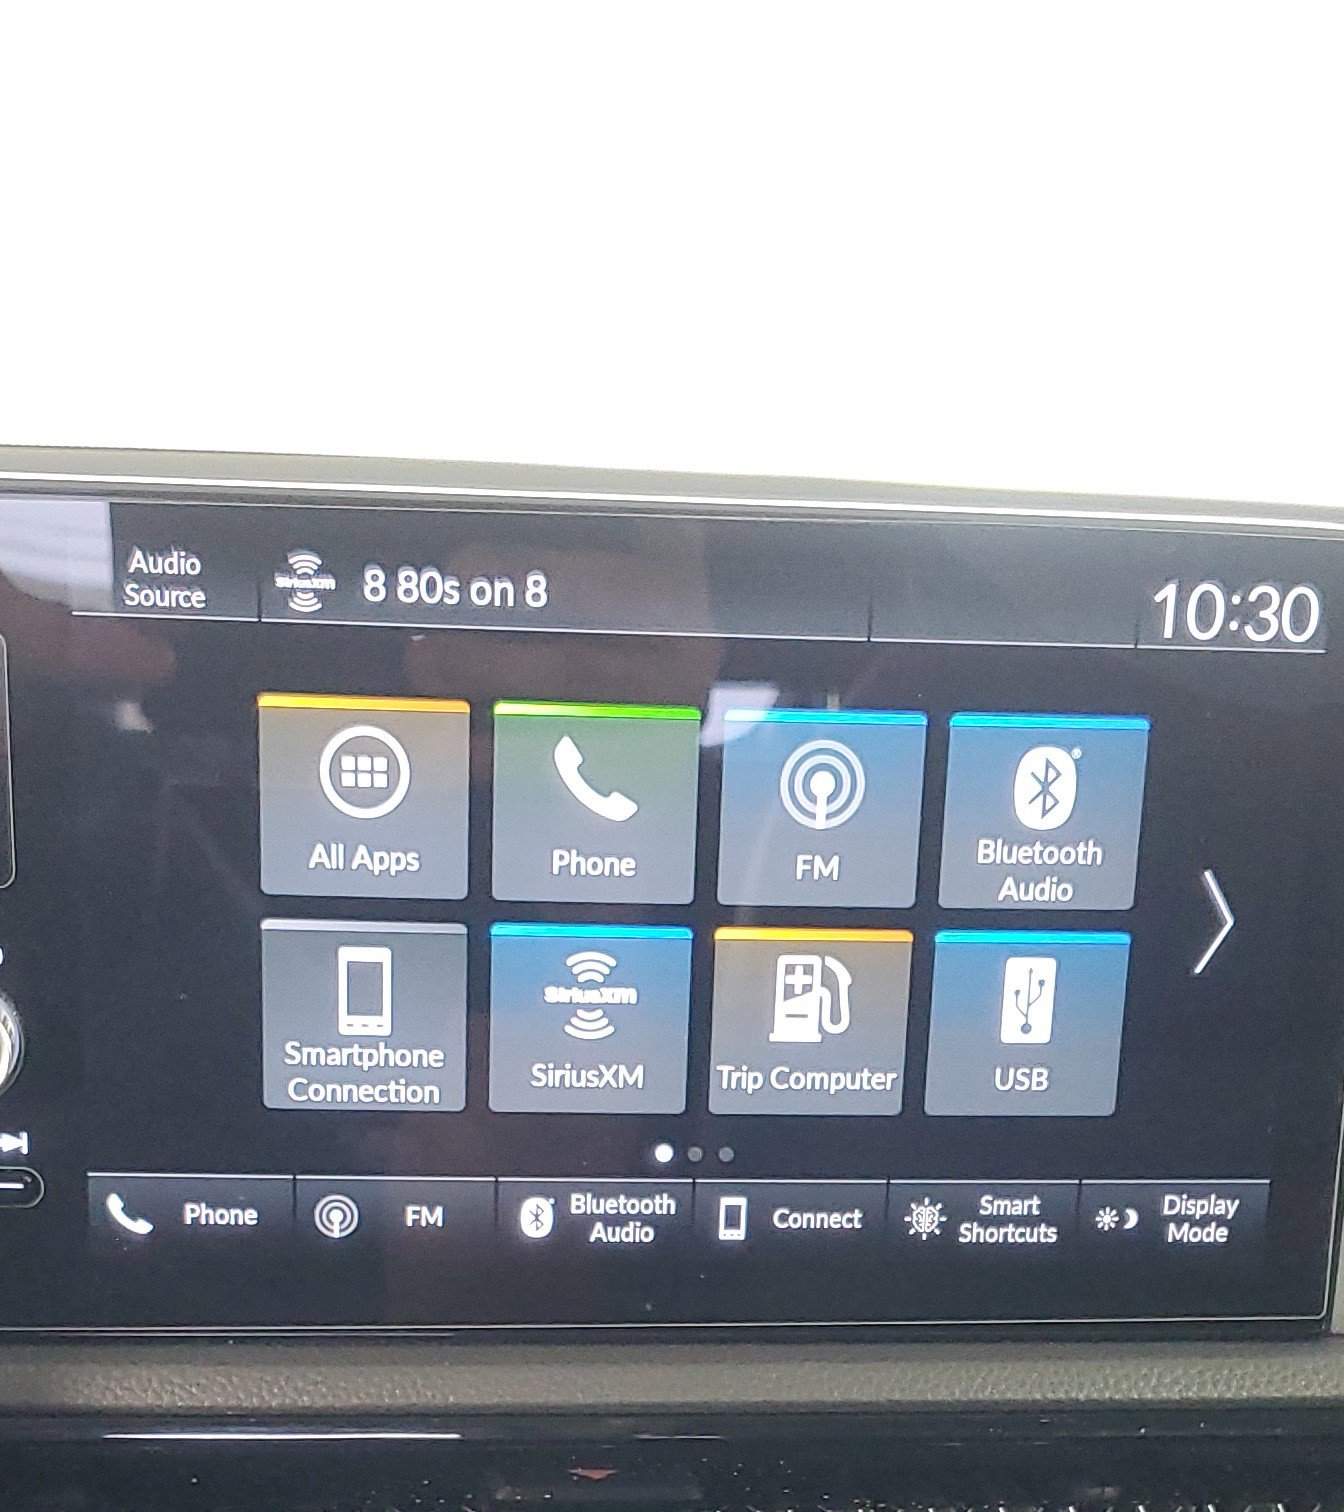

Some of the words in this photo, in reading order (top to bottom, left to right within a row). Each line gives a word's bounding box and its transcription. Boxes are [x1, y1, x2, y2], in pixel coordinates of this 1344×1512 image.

[127, 548, 202, 580] Audio
[124, 580, 206, 612] Source
[363, 565, 387, 602] 8
[396, 567, 461, 606] 80s
[469, 578, 516, 608] on
[524, 570, 549, 609] 8
[1153, 578, 1321, 645] 10:30
[308, 842, 345, 873] All
[350, 844, 421, 878] Apps
[551, 849, 637, 878] Phone
[795, 853, 840, 882] FM
[976, 838, 1103, 868] Bluetooth
[998, 874, 1074, 904] Audio
[284, 1041, 445, 1075] Smartphone
[286, 1076, 441, 1106] Connection
[529, 1063, 644, 1091] SiriusXM
[716, 1064, 764, 1096] Trip
[770, 1065, 899, 1096] Computer
[993, 1066, 1050, 1093] USB
[183, 1200, 260, 1228] Phone
[404, 1204, 445, 1229] FM
[568, 1191, 677, 1218] Bluetooth
[772, 1206, 863, 1231] Connect
[978, 1195, 1042, 1219] Smart
[1162, 1194, 1240, 1224] Display
[589, 1220, 656, 1246] Audio
[958, 1220, 1058, 1246] Shortcuts
[1166, 1220, 1229, 1246] Mode
